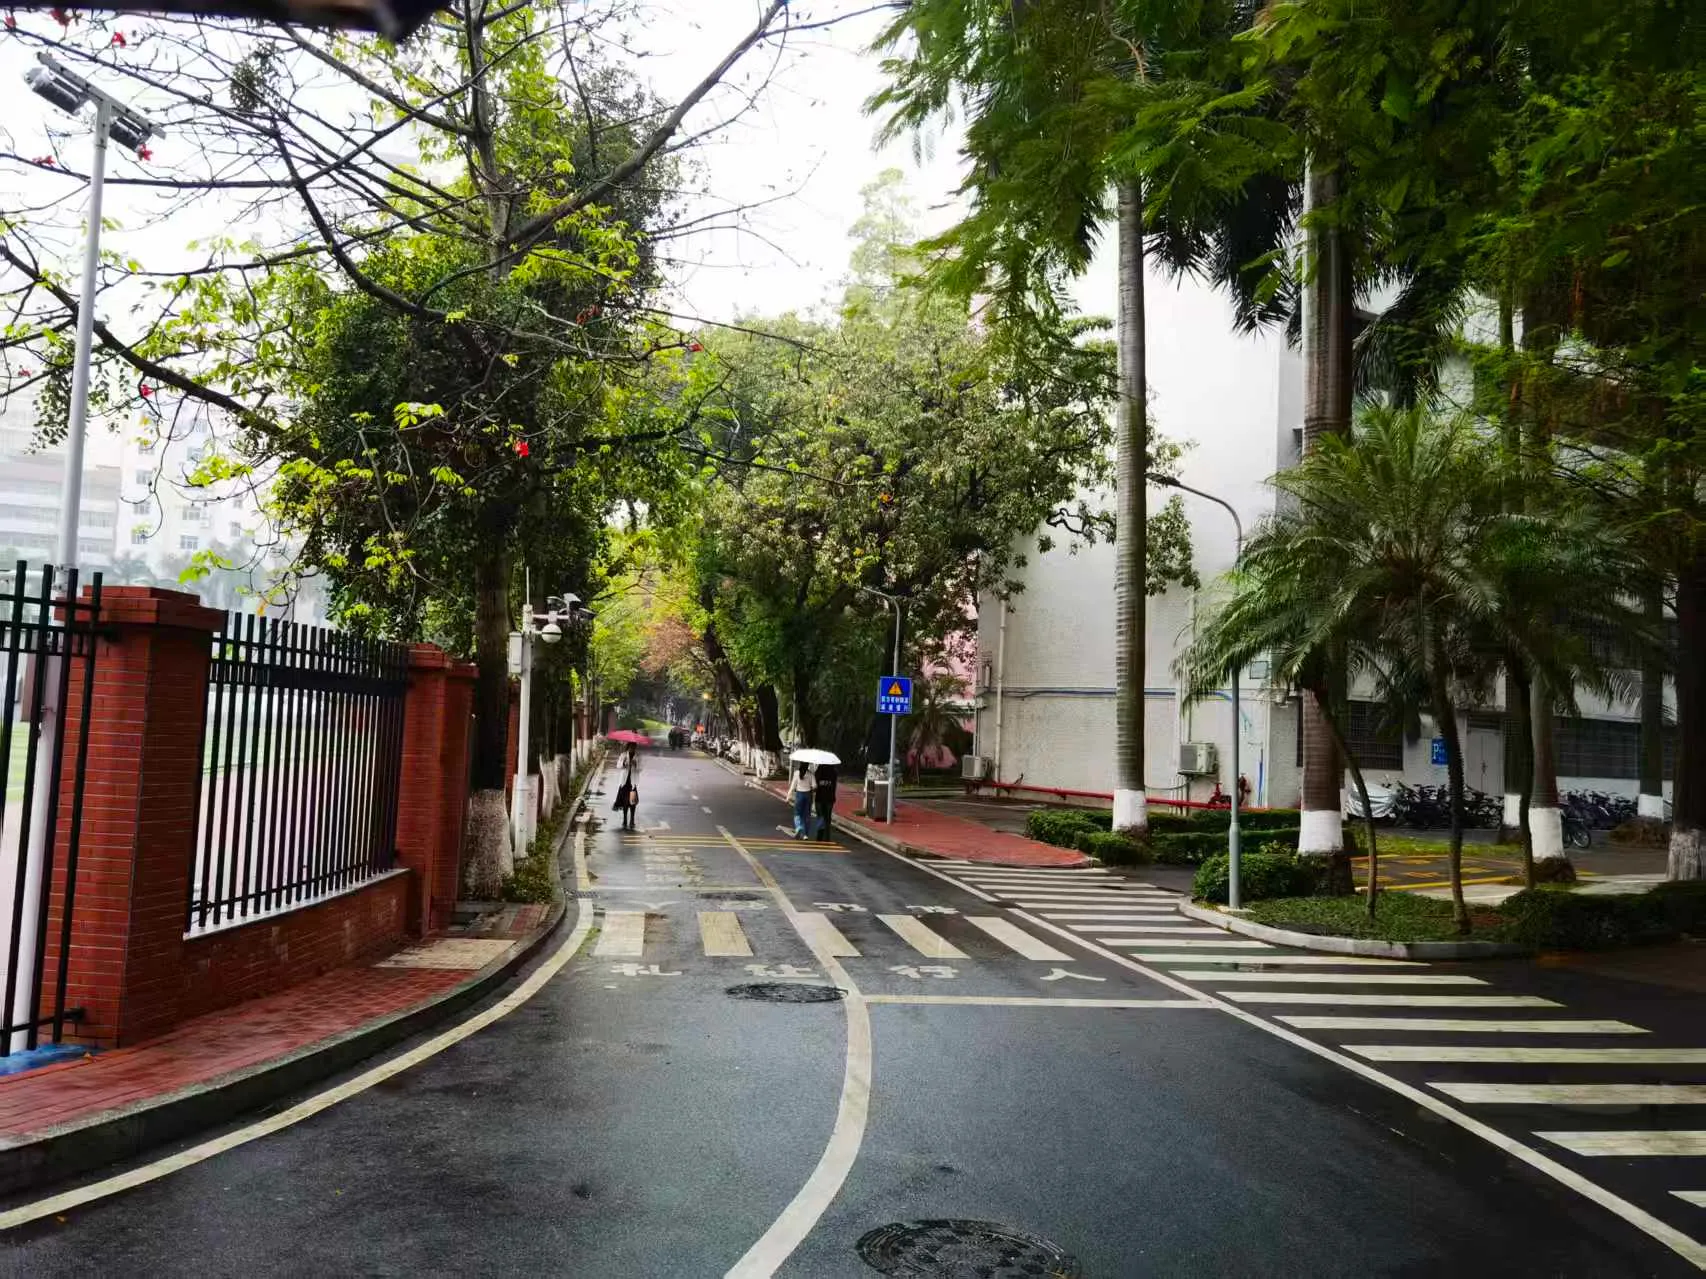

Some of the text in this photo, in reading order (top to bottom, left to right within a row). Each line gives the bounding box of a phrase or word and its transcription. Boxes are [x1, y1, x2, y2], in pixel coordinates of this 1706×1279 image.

[1433, 743, 1440, 760] P
[611, 963, 1107, 981] 礼让行人
